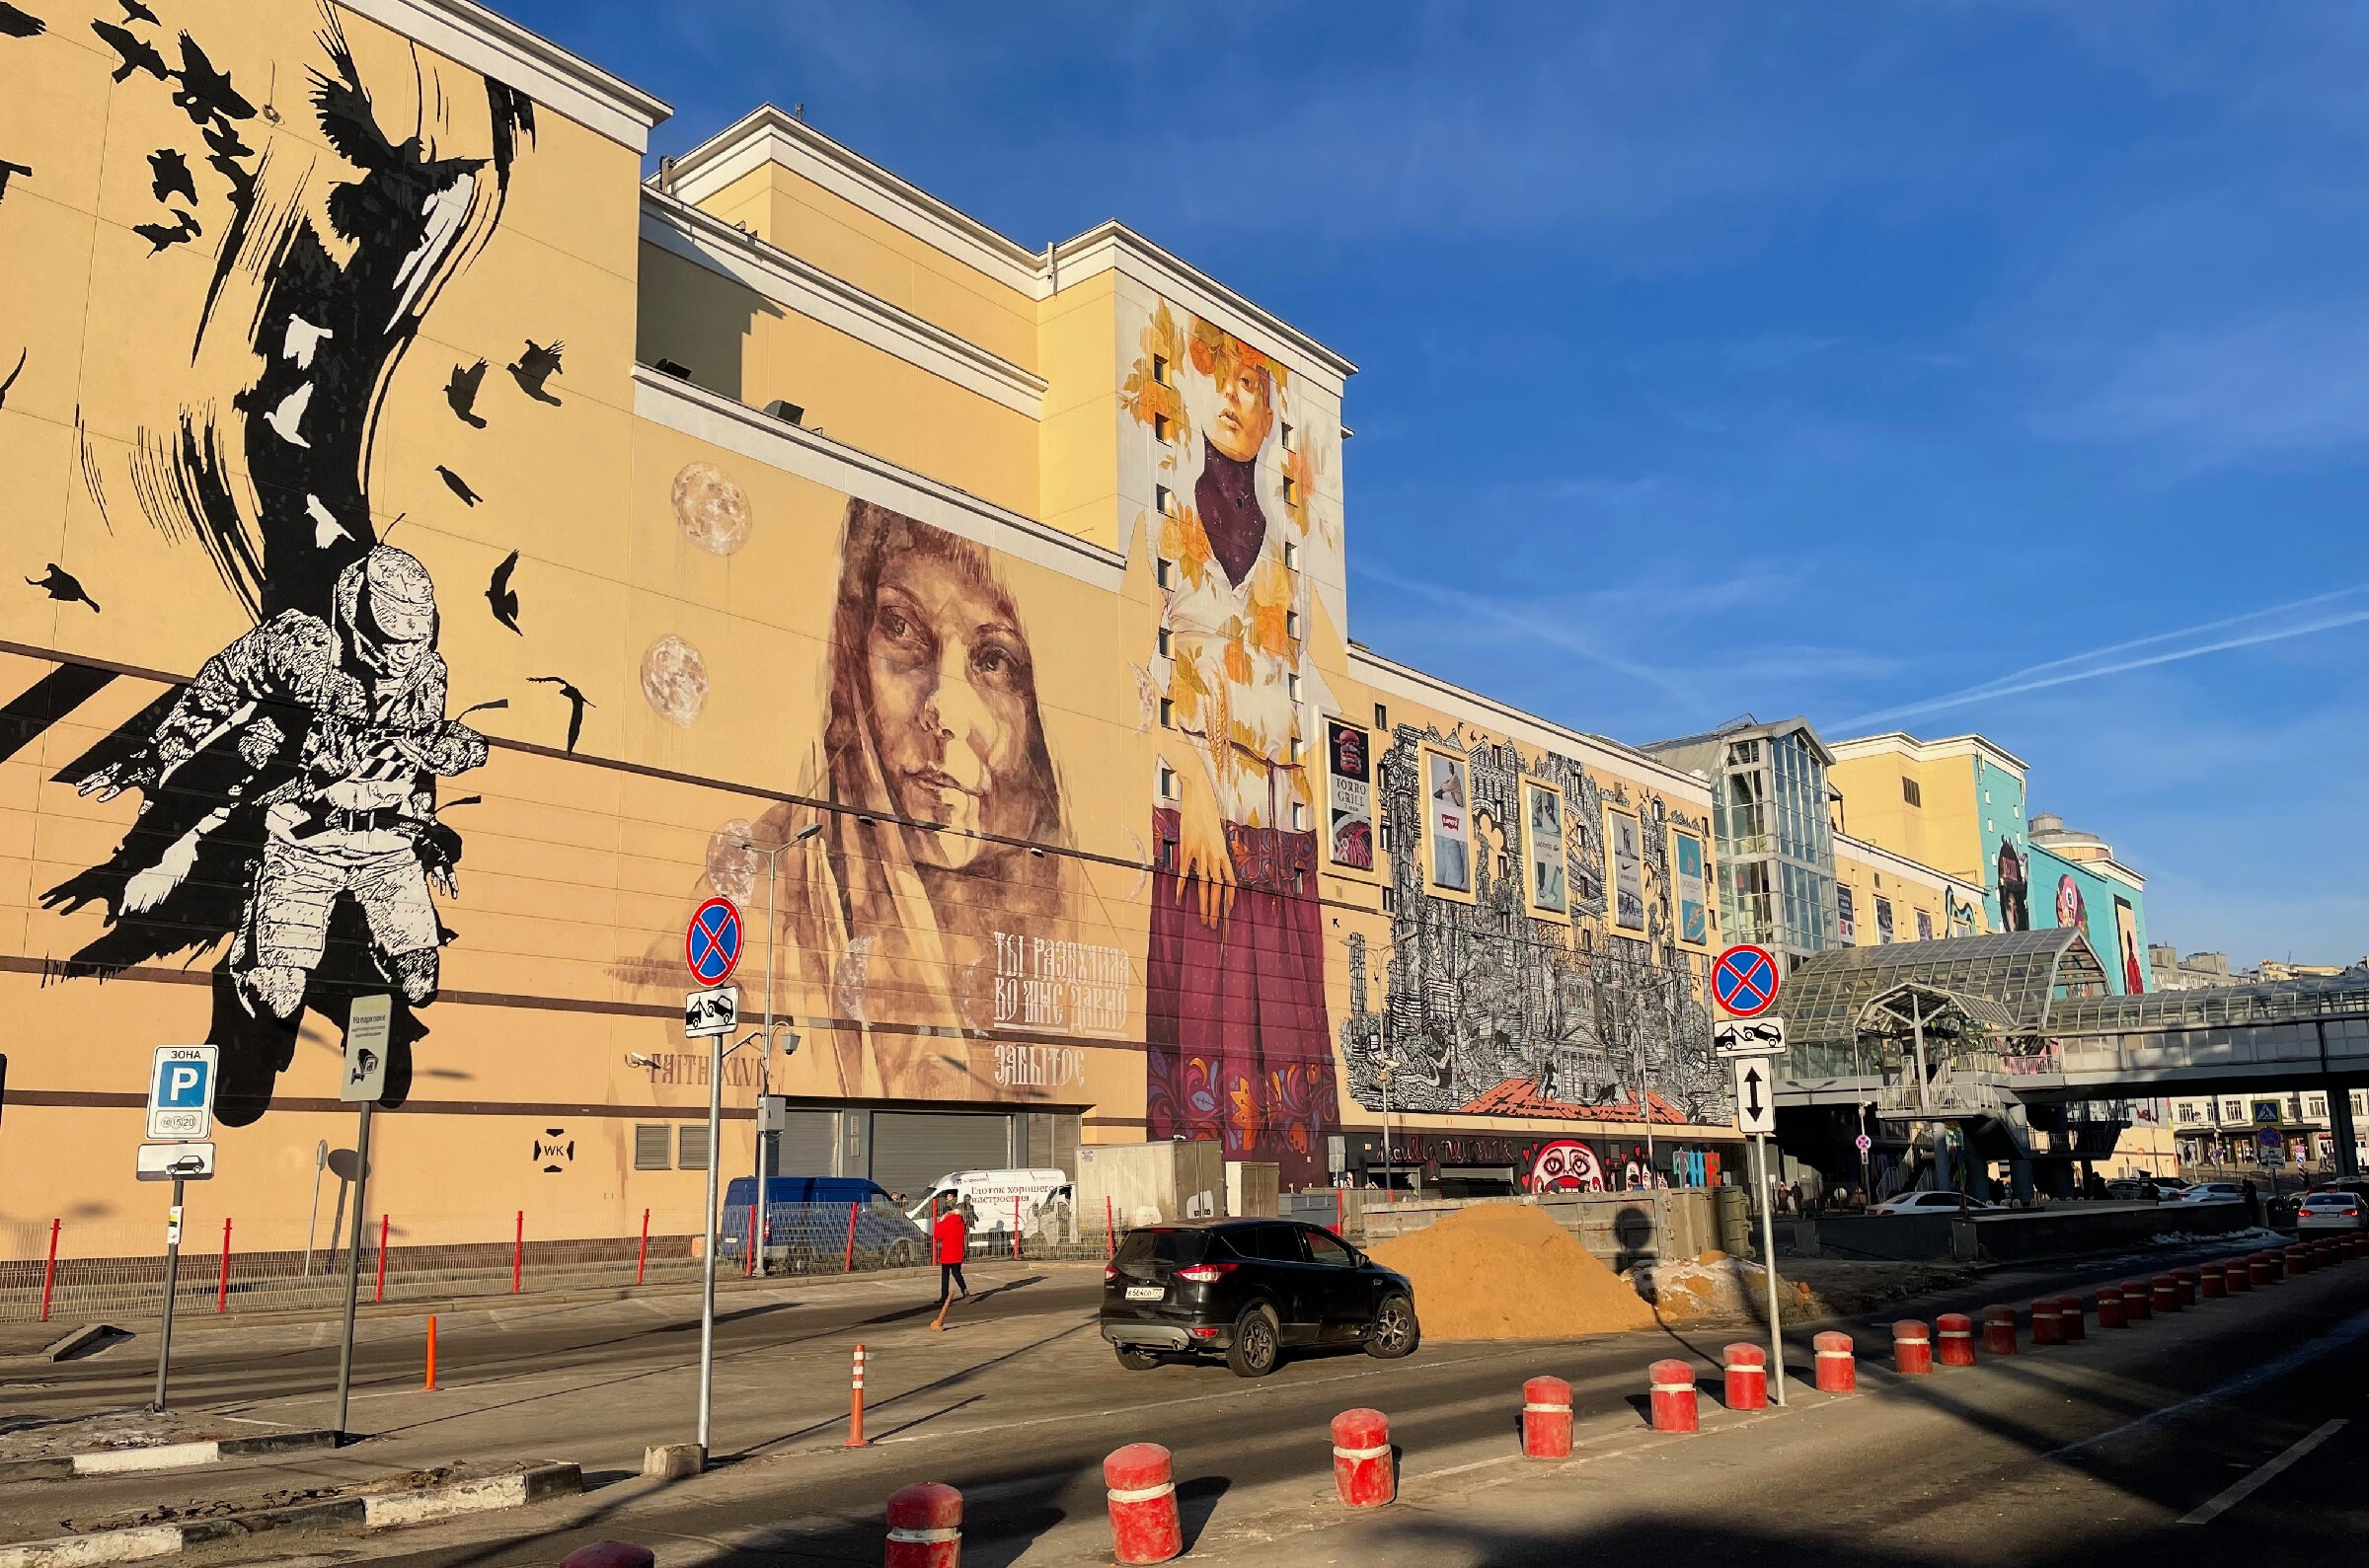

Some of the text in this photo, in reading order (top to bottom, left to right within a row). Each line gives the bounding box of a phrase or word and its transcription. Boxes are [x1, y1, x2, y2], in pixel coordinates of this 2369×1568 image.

[1336, 778, 1366, 794] TORRO
[1337, 791, 1364, 806] GRILL
[993, 931, 1024, 977] ТЫ
[994, 977, 1018, 1021] ВО
[171, 1050, 201, 1059] ЗОНА
[170, 1067, 198, 1101] P
[544, 1145, 564, 1157] WK
[971, 1185, 1054, 1196] Глоток хорошего
